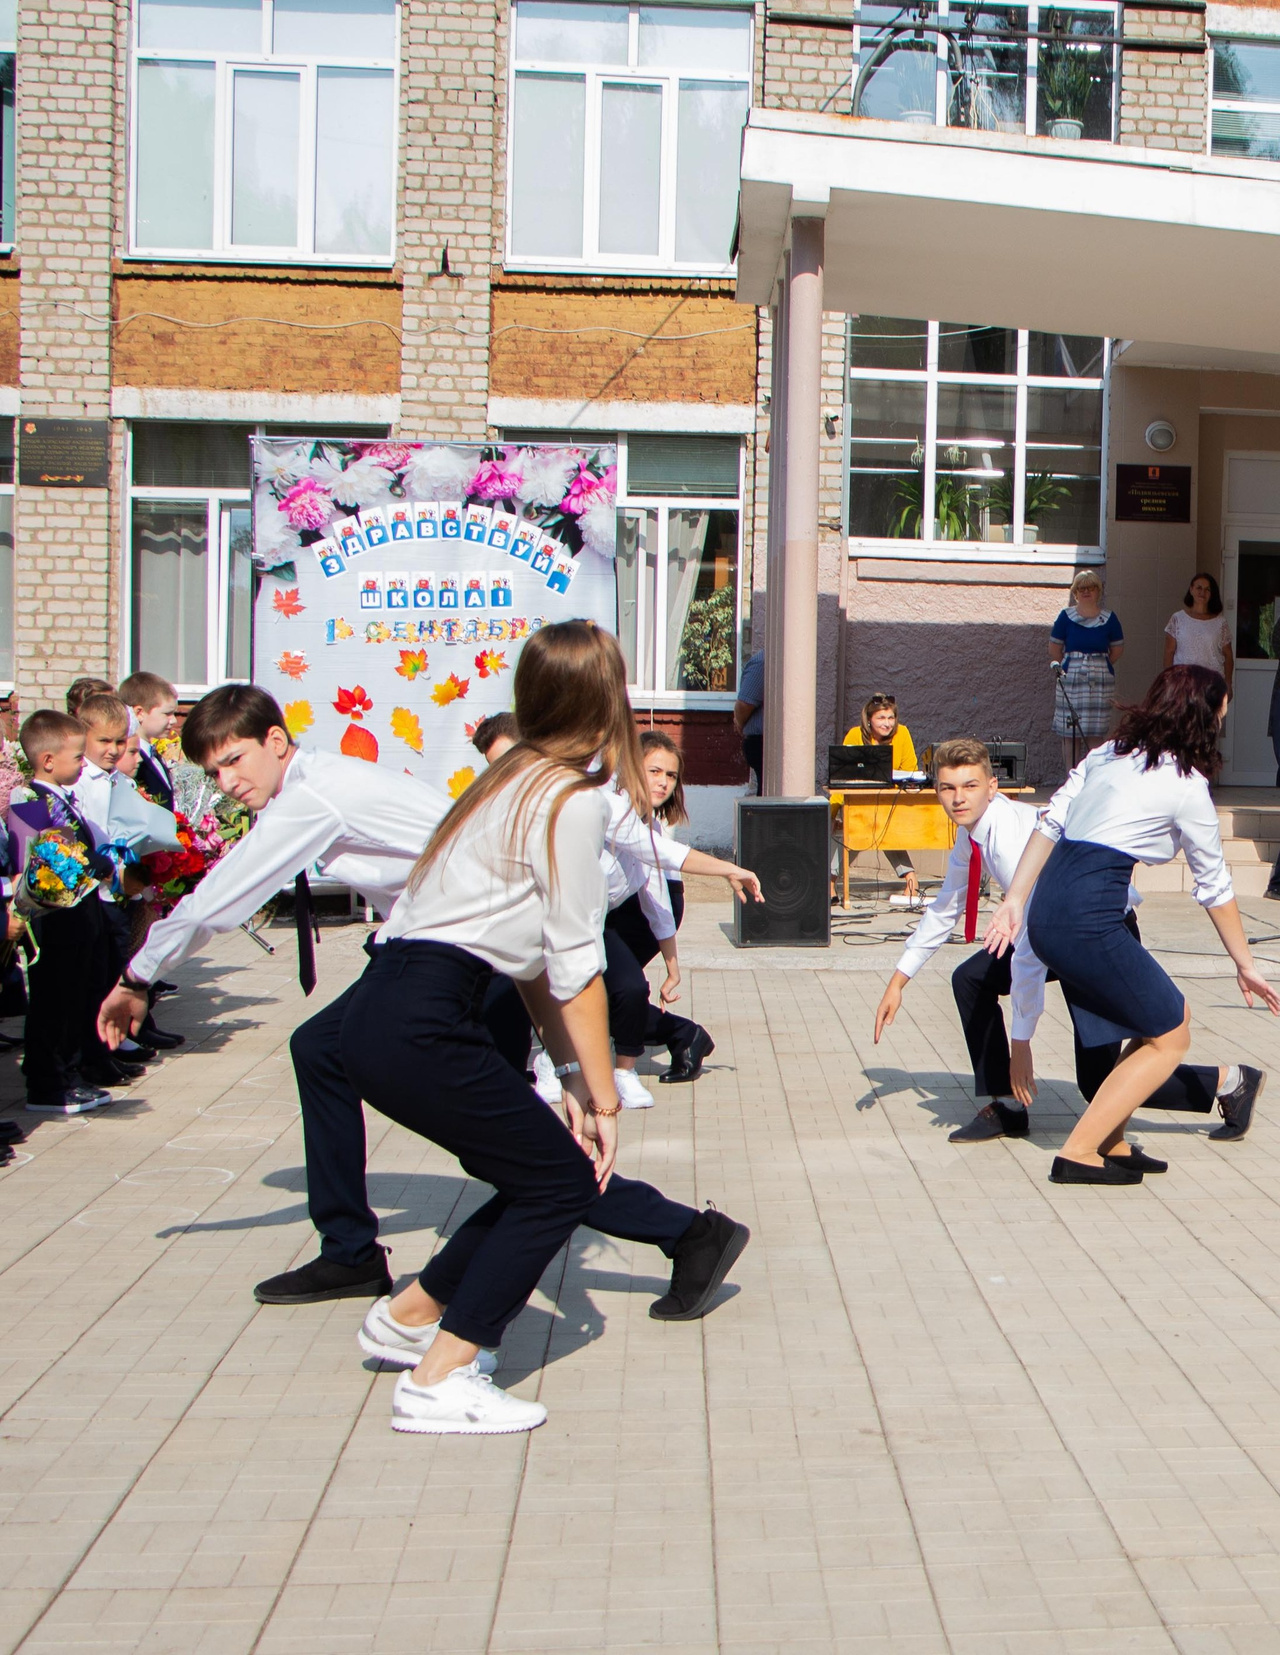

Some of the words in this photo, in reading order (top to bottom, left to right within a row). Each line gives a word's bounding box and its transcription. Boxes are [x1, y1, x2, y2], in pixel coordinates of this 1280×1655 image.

[326, 522, 562, 592] ЗДРАВСТВУЙ,
[360, 591, 507, 607] ШКОЛА!
[326, 618, 336, 643] 1
